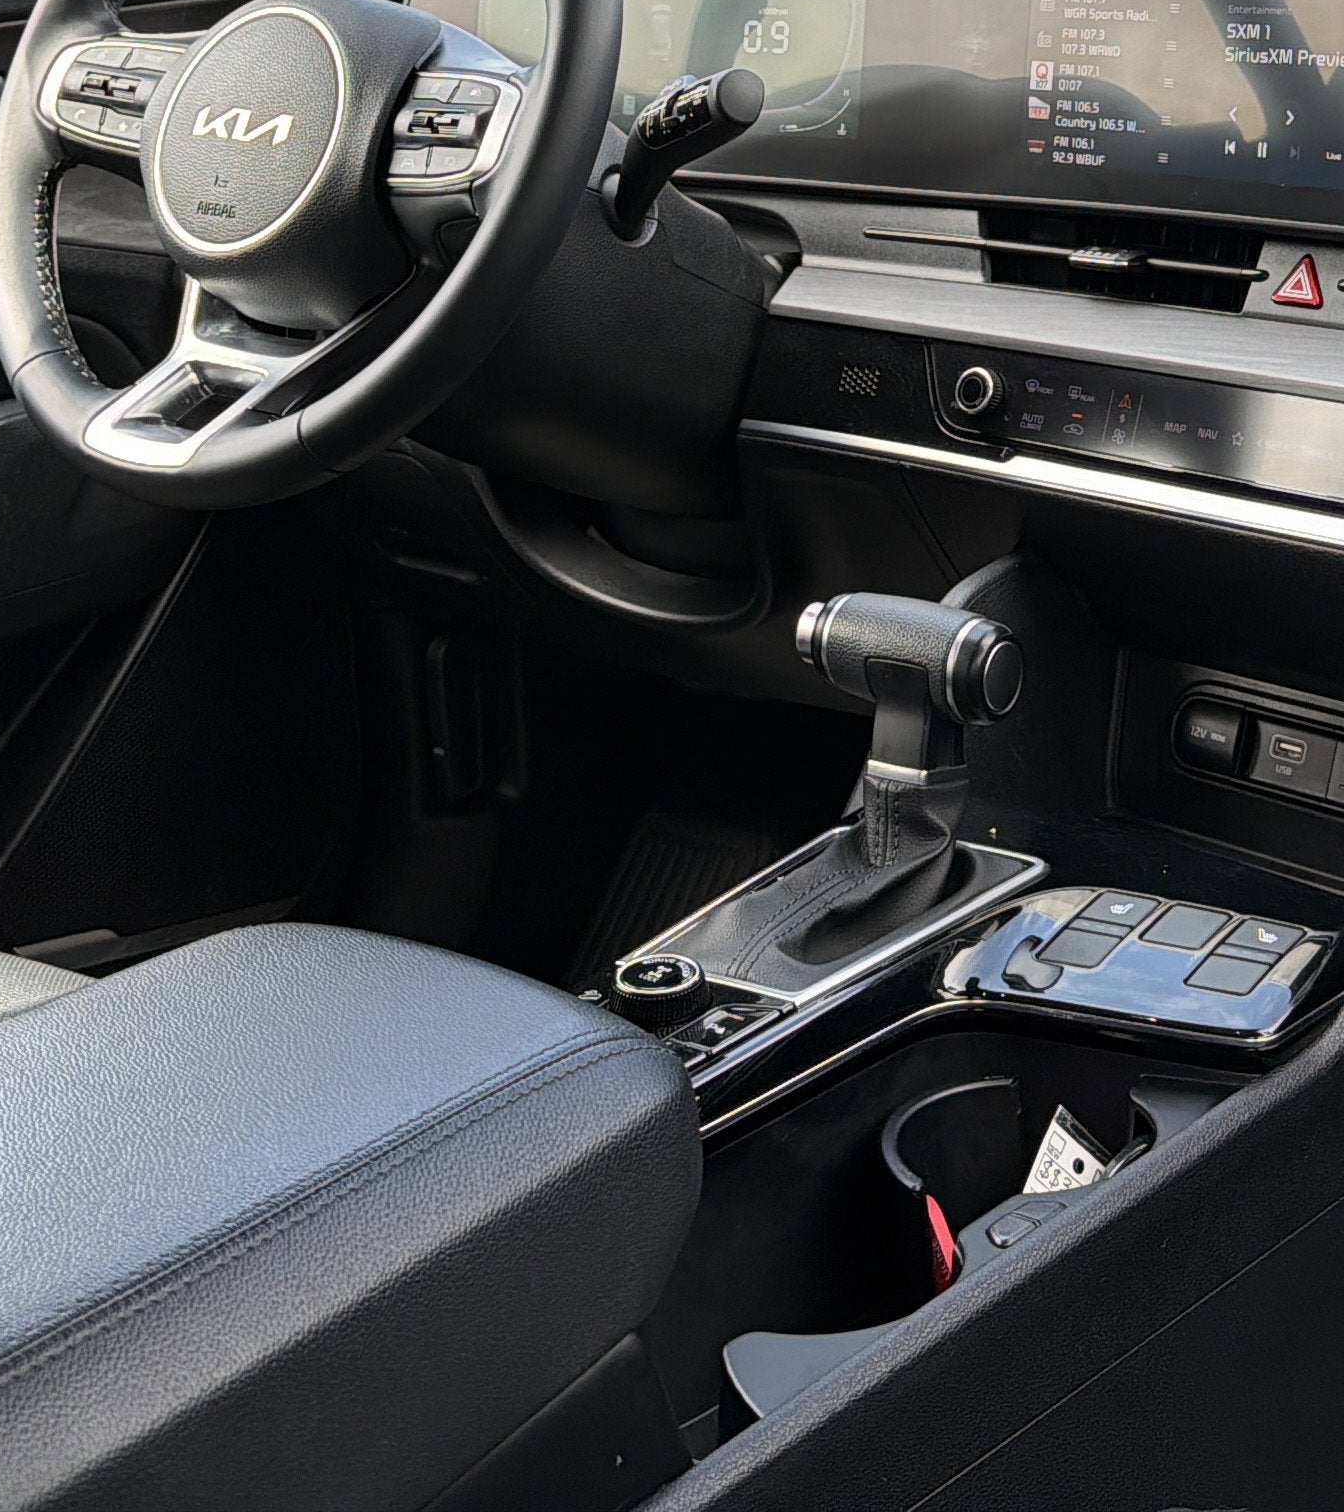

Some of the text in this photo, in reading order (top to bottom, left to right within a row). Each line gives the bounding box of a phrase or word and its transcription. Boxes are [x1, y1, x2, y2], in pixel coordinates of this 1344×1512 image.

[1089, 8, 1124, 22] Sports
[1227, 4, 1293, 17] Entertainment
[743, 20, 791, 55] 0.9
[1062, 28, 1106, 41] FM 107.3
[1226, 23, 1271, 40] SXM 1
[1061, 43, 1086, 56] 107.3
[1224, 46, 1294, 65] SiriusXM
[1059, 64, 1100, 77] FM 107.1
[1058, 79, 1083, 92] Q107
[1056, 99, 1072, 112] FM
[1074, 100, 1100, 113] 106.5
[192, 106, 295, 148] KIA
[1054, 115, 1097, 131] Country
[1098, 118, 1125, 131] 106.5
[1053, 135, 1095, 150] FM 106.1
[1052, 151, 1106, 167] 92.9 WBUF
[196, 199, 237, 219] AIRBAG
[1021, 412, 1045, 425] AUTO
[1019, 422, 1043, 432] CLIMATE
[1163, 421, 1187, 434] MAP
[1197, 427, 1219, 441] NAV
[1190, 725, 1208, 739] 12V
[1275, 764, 1293, 776] USB
